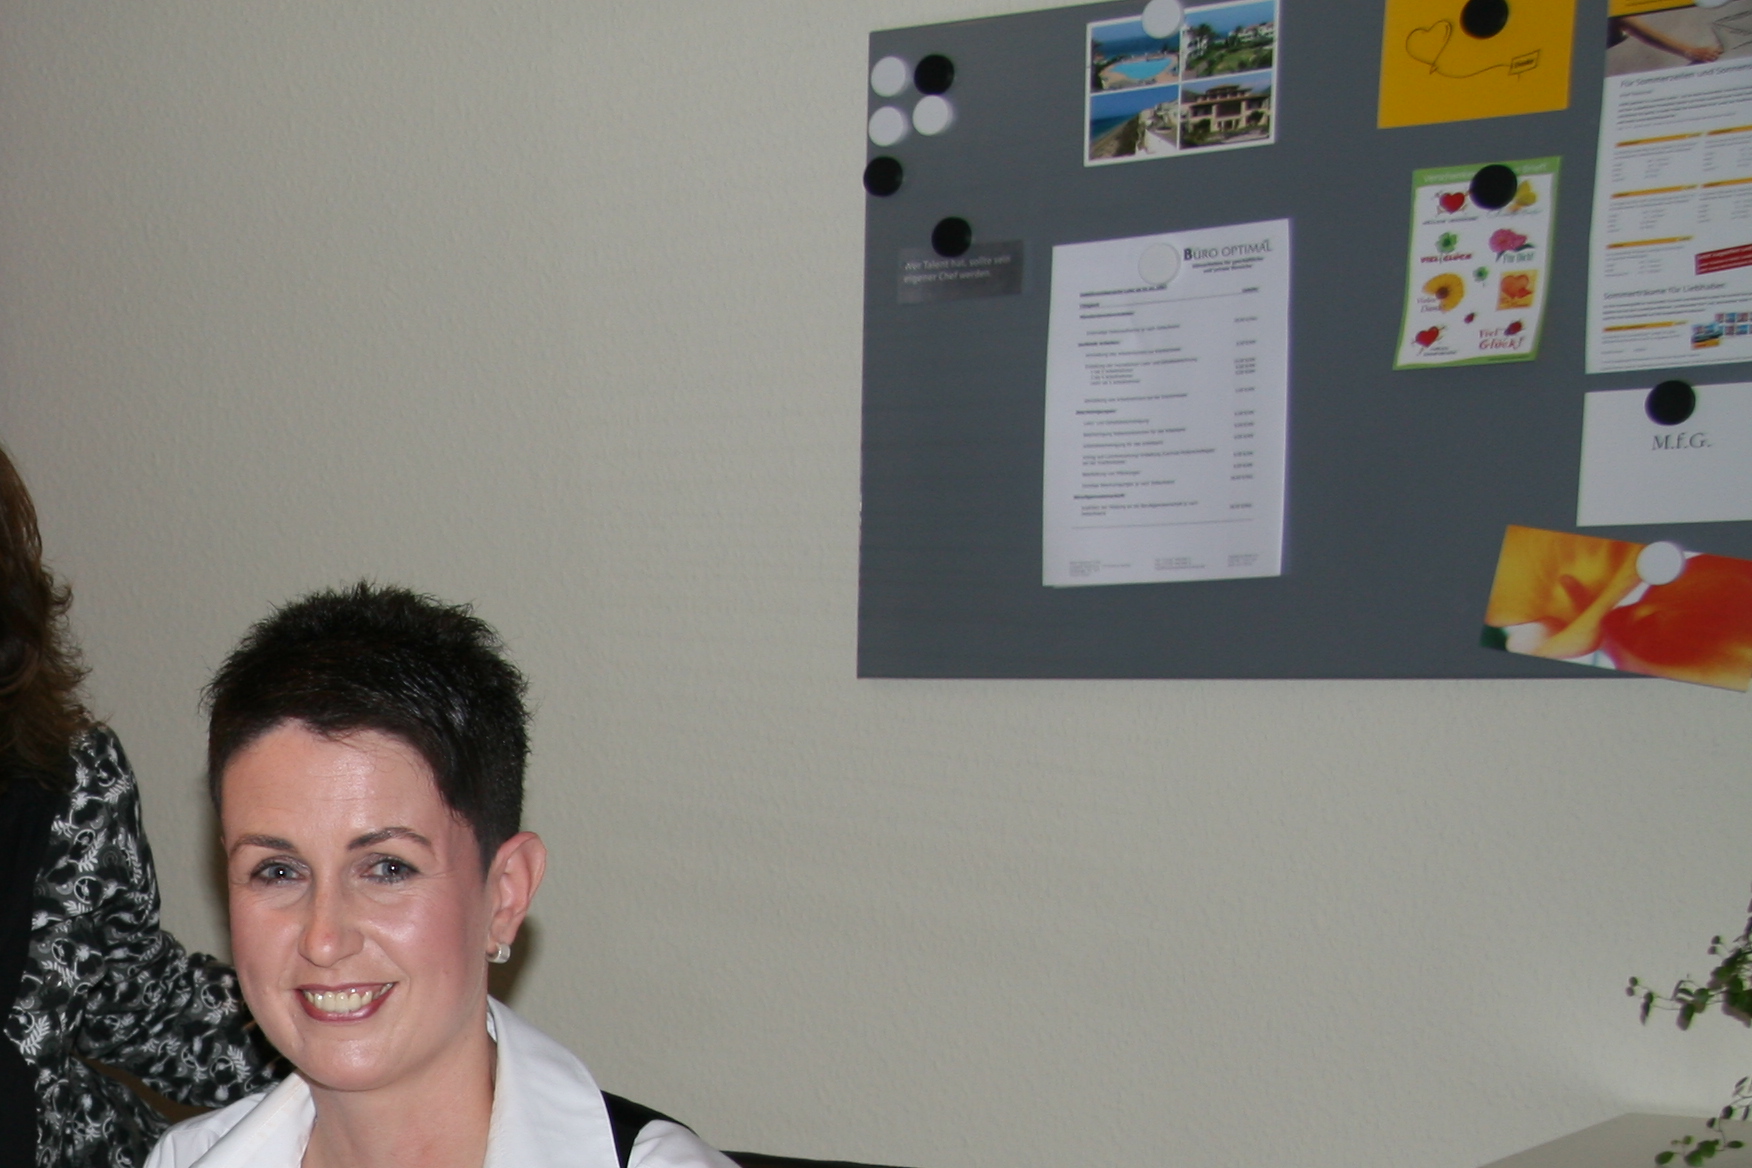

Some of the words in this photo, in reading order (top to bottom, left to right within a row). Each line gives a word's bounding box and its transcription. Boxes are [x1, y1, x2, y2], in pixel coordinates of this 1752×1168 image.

[1221, 239, 1273, 257] OPTIMAL
[922, 260, 949, 269] Talent
[968, 257, 992, 267] sollte
[938, 271, 959, 280] Chef
[1478, 329, 1499, 339] Viel
[1478, 337, 1525, 351] Glück!
[1652, 432, 1712, 450] M.f.G.
